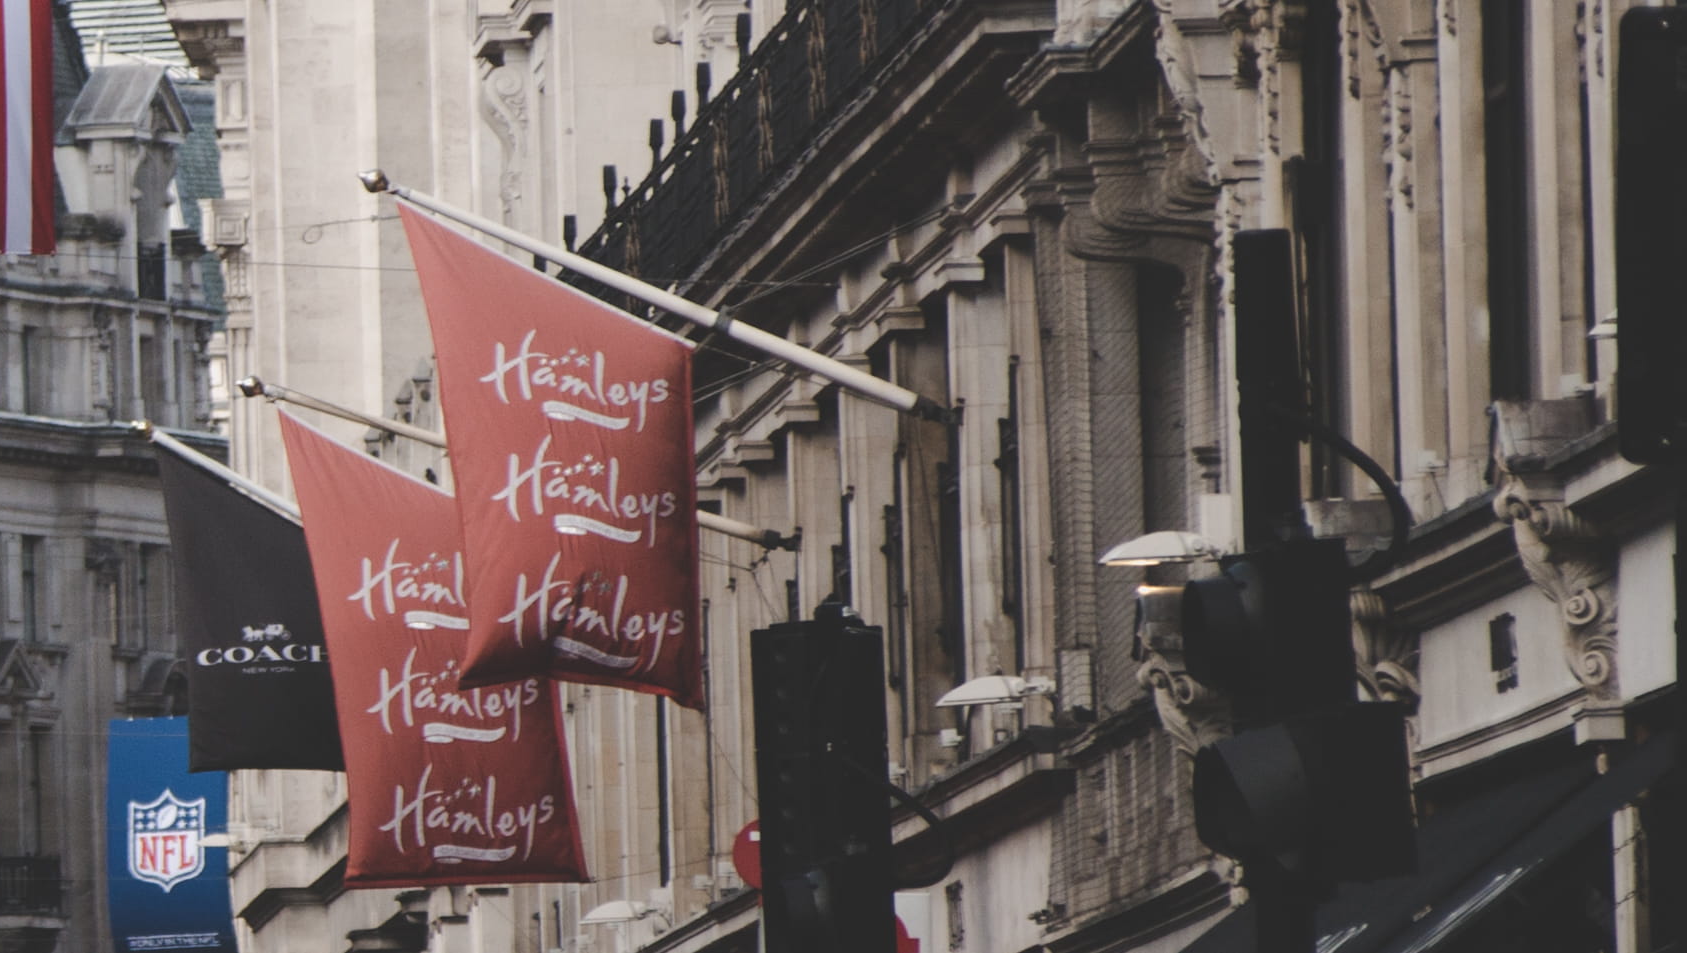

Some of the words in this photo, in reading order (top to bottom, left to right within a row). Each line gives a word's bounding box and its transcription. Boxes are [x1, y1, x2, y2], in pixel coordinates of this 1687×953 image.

[479, 328, 670, 433] Hamleys
[491, 434, 676, 547] Hamleys
[347, 537, 467, 621] Haml
[497, 551, 685, 673] Hamleys
[366, 647, 539, 743] Hamleys
[138, 834, 195, 876] NFL
[378, 762, 555, 862] Hamleys
